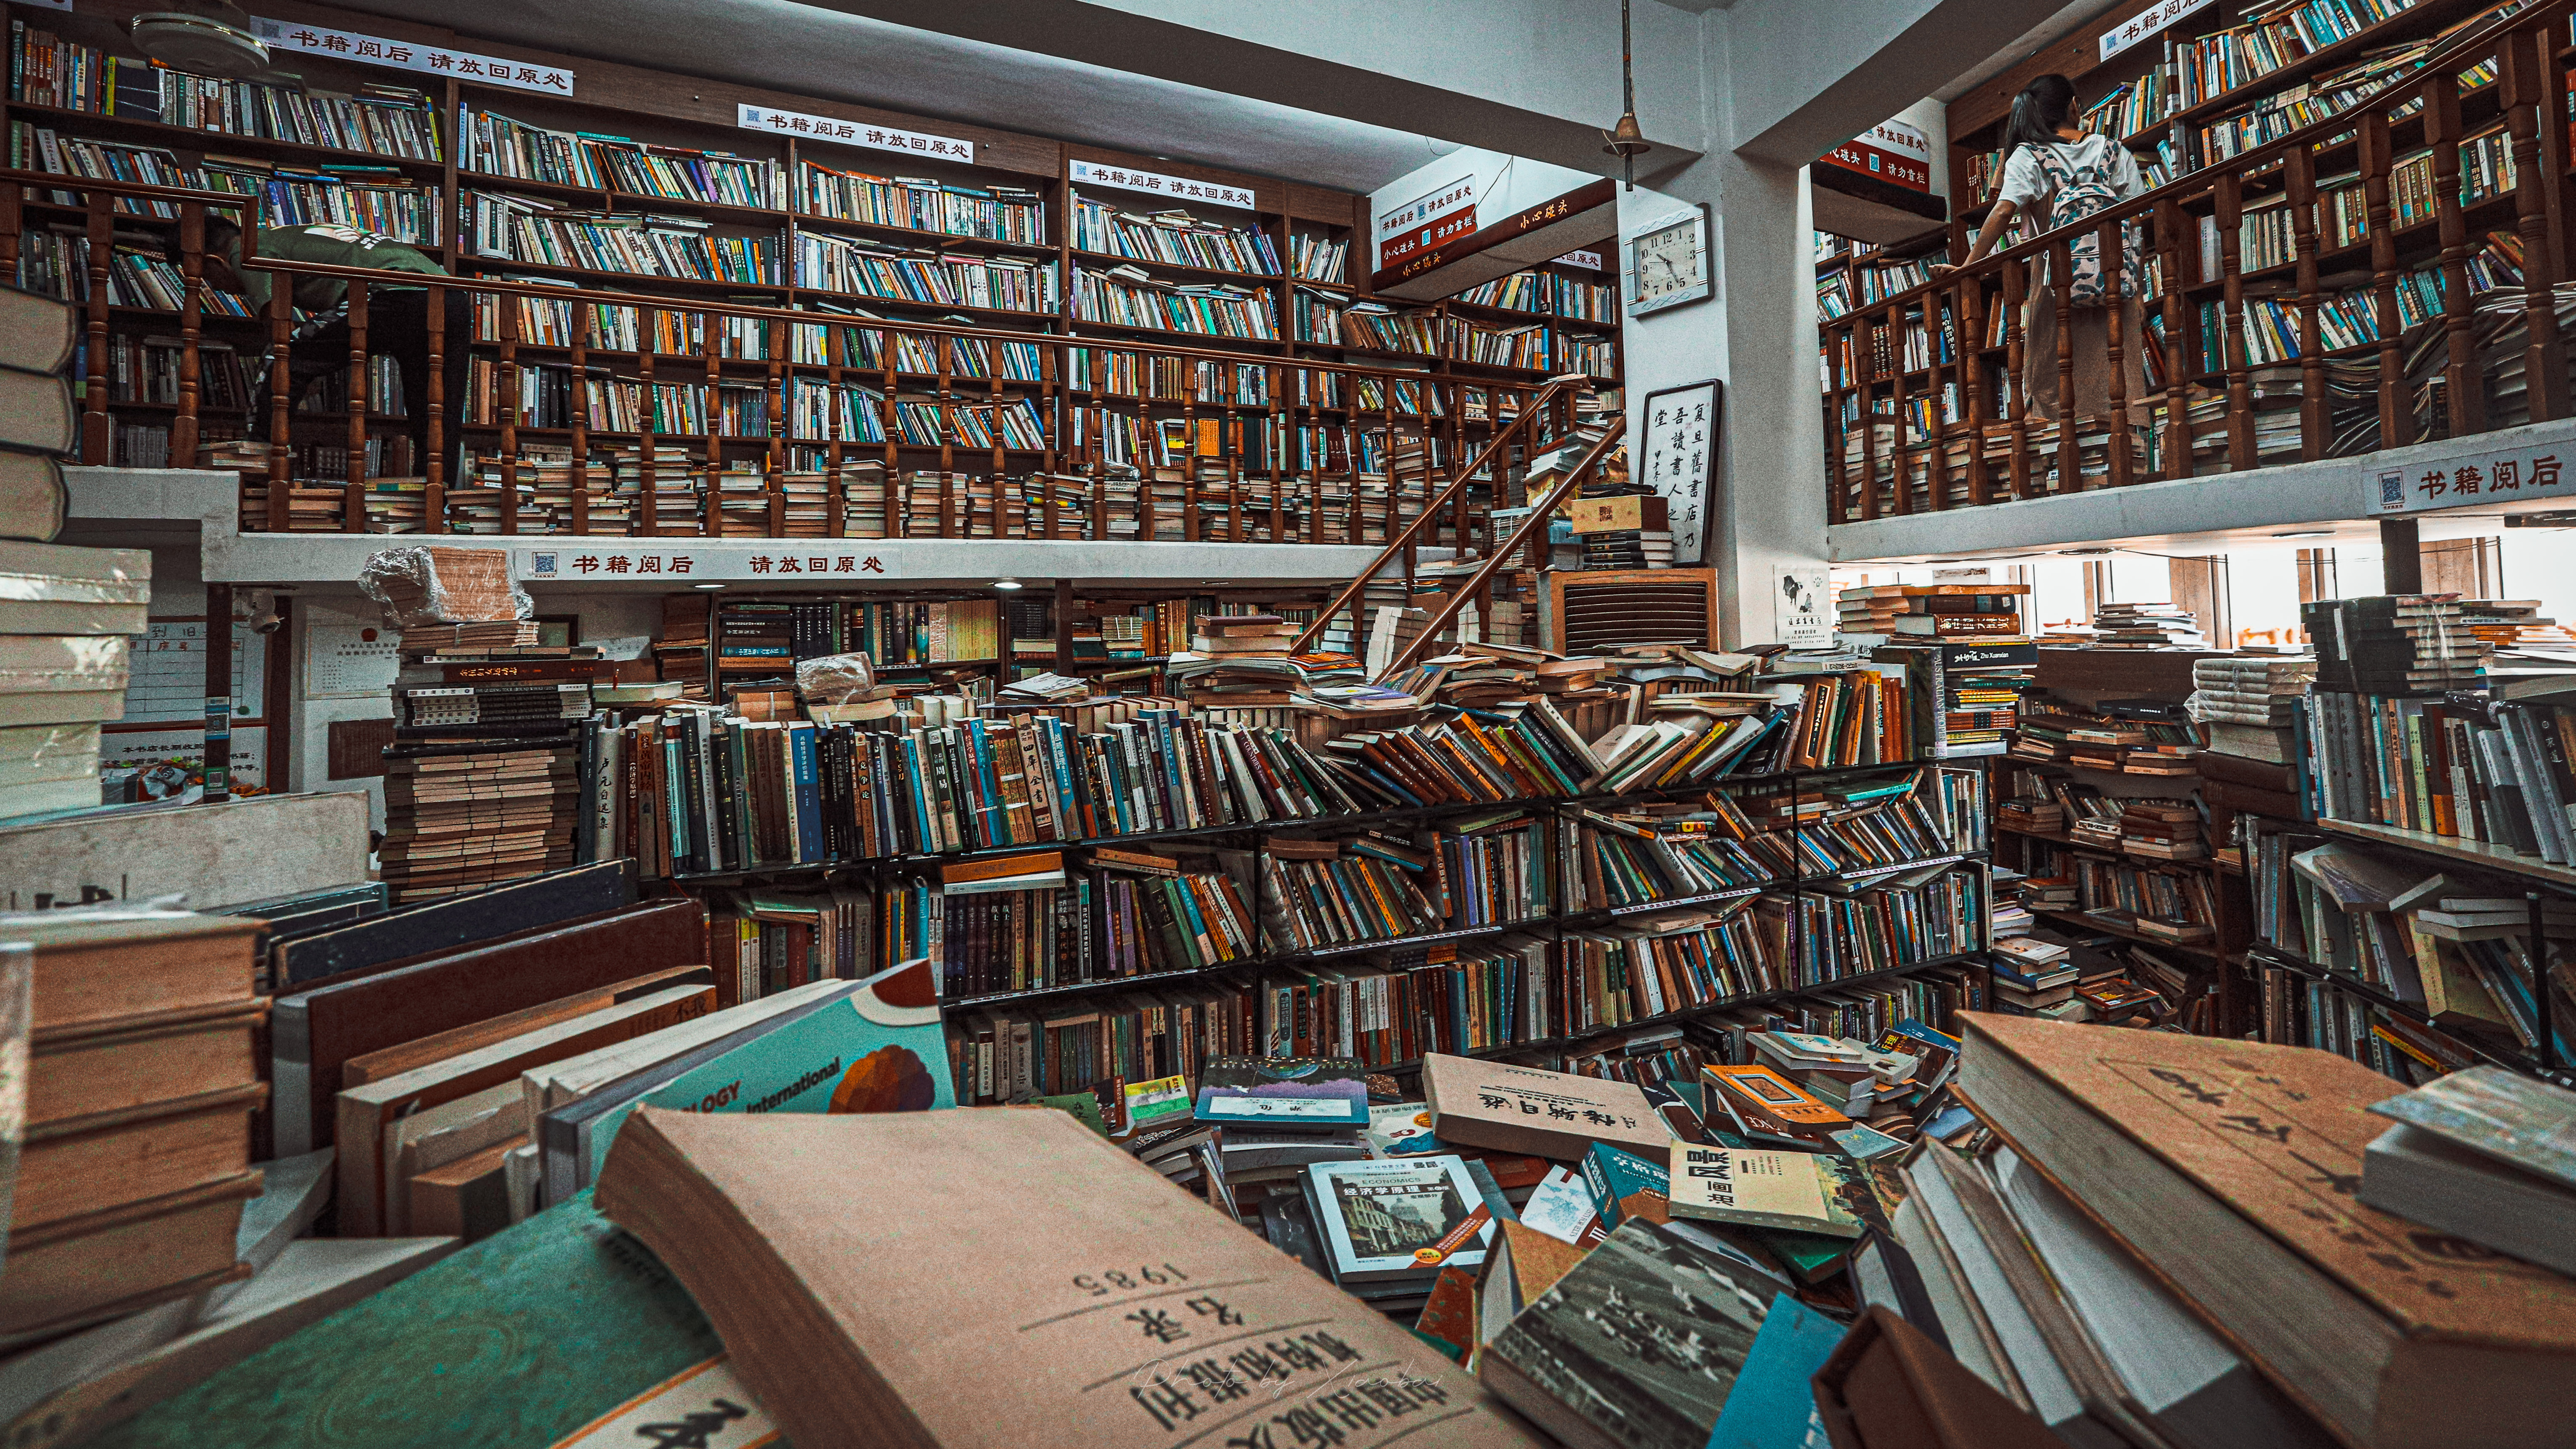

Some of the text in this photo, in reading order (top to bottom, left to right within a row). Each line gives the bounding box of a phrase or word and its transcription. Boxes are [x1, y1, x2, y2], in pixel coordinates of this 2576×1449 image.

[290, 30, 567, 89] 书籍阅后 请放回原处
[767, 115, 969, 158] 书籍阅后 请放回原处
[1877, 125, 1925, 152] 请放回原处
[1888, 163, 1925, 184] 请勿靠栏
[1092, 169, 1251, 205] 书籍阅后 请放回原处
[1382, 186, 1471, 231] 书籍阅后 请放回原处
[1520, 200, 1567, 228] 小心碰头
[1384, 216, 1472, 259] 小心碰头 请勿靠栏
[1651, 238, 1658, 248] 11
[1663, 233, 1672, 244] 12
[1679, 230, 1682, 239] 1
[1689, 233, 1695, 243] 2
[1403, 253, 1440, 276] 小心碰头
[1641, 249, 1648, 259] 10
[1690, 250, 1695, 260] 3
[1643, 265, 1648, 274] 9
[1691, 266, 1696, 276] 4
[1644, 281, 1649, 290] 8
[1653, 285, 1659, 295] 7
[1667, 281, 1672, 290] 6
[1680, 277, 1685, 287] 5
[1655, 410, 1667, 427] 堂
[1668, 407, 1688, 546] 吾讀書人之
[2419, 455, 2563, 500] 书籍阅后
[572, 555, 885, 574] 书籍阅后 请放回原处
[1244, 741, 1261, 770] COUNTRIES
[935, 766, 947, 789] 周易
[597, 758, 612, 829] 卢元自选集
[747, 1056, 839, 1114] International
[1687, 1150, 1734, 1207] 油画风景
[1343, 1185, 1421, 1196] 经济学原理
[1073, 1263, 1190, 1296] 1985
[1125, 1294, 1245, 1345] 名录
[1129, 1328, 1364, 1430] 机构和报刊
